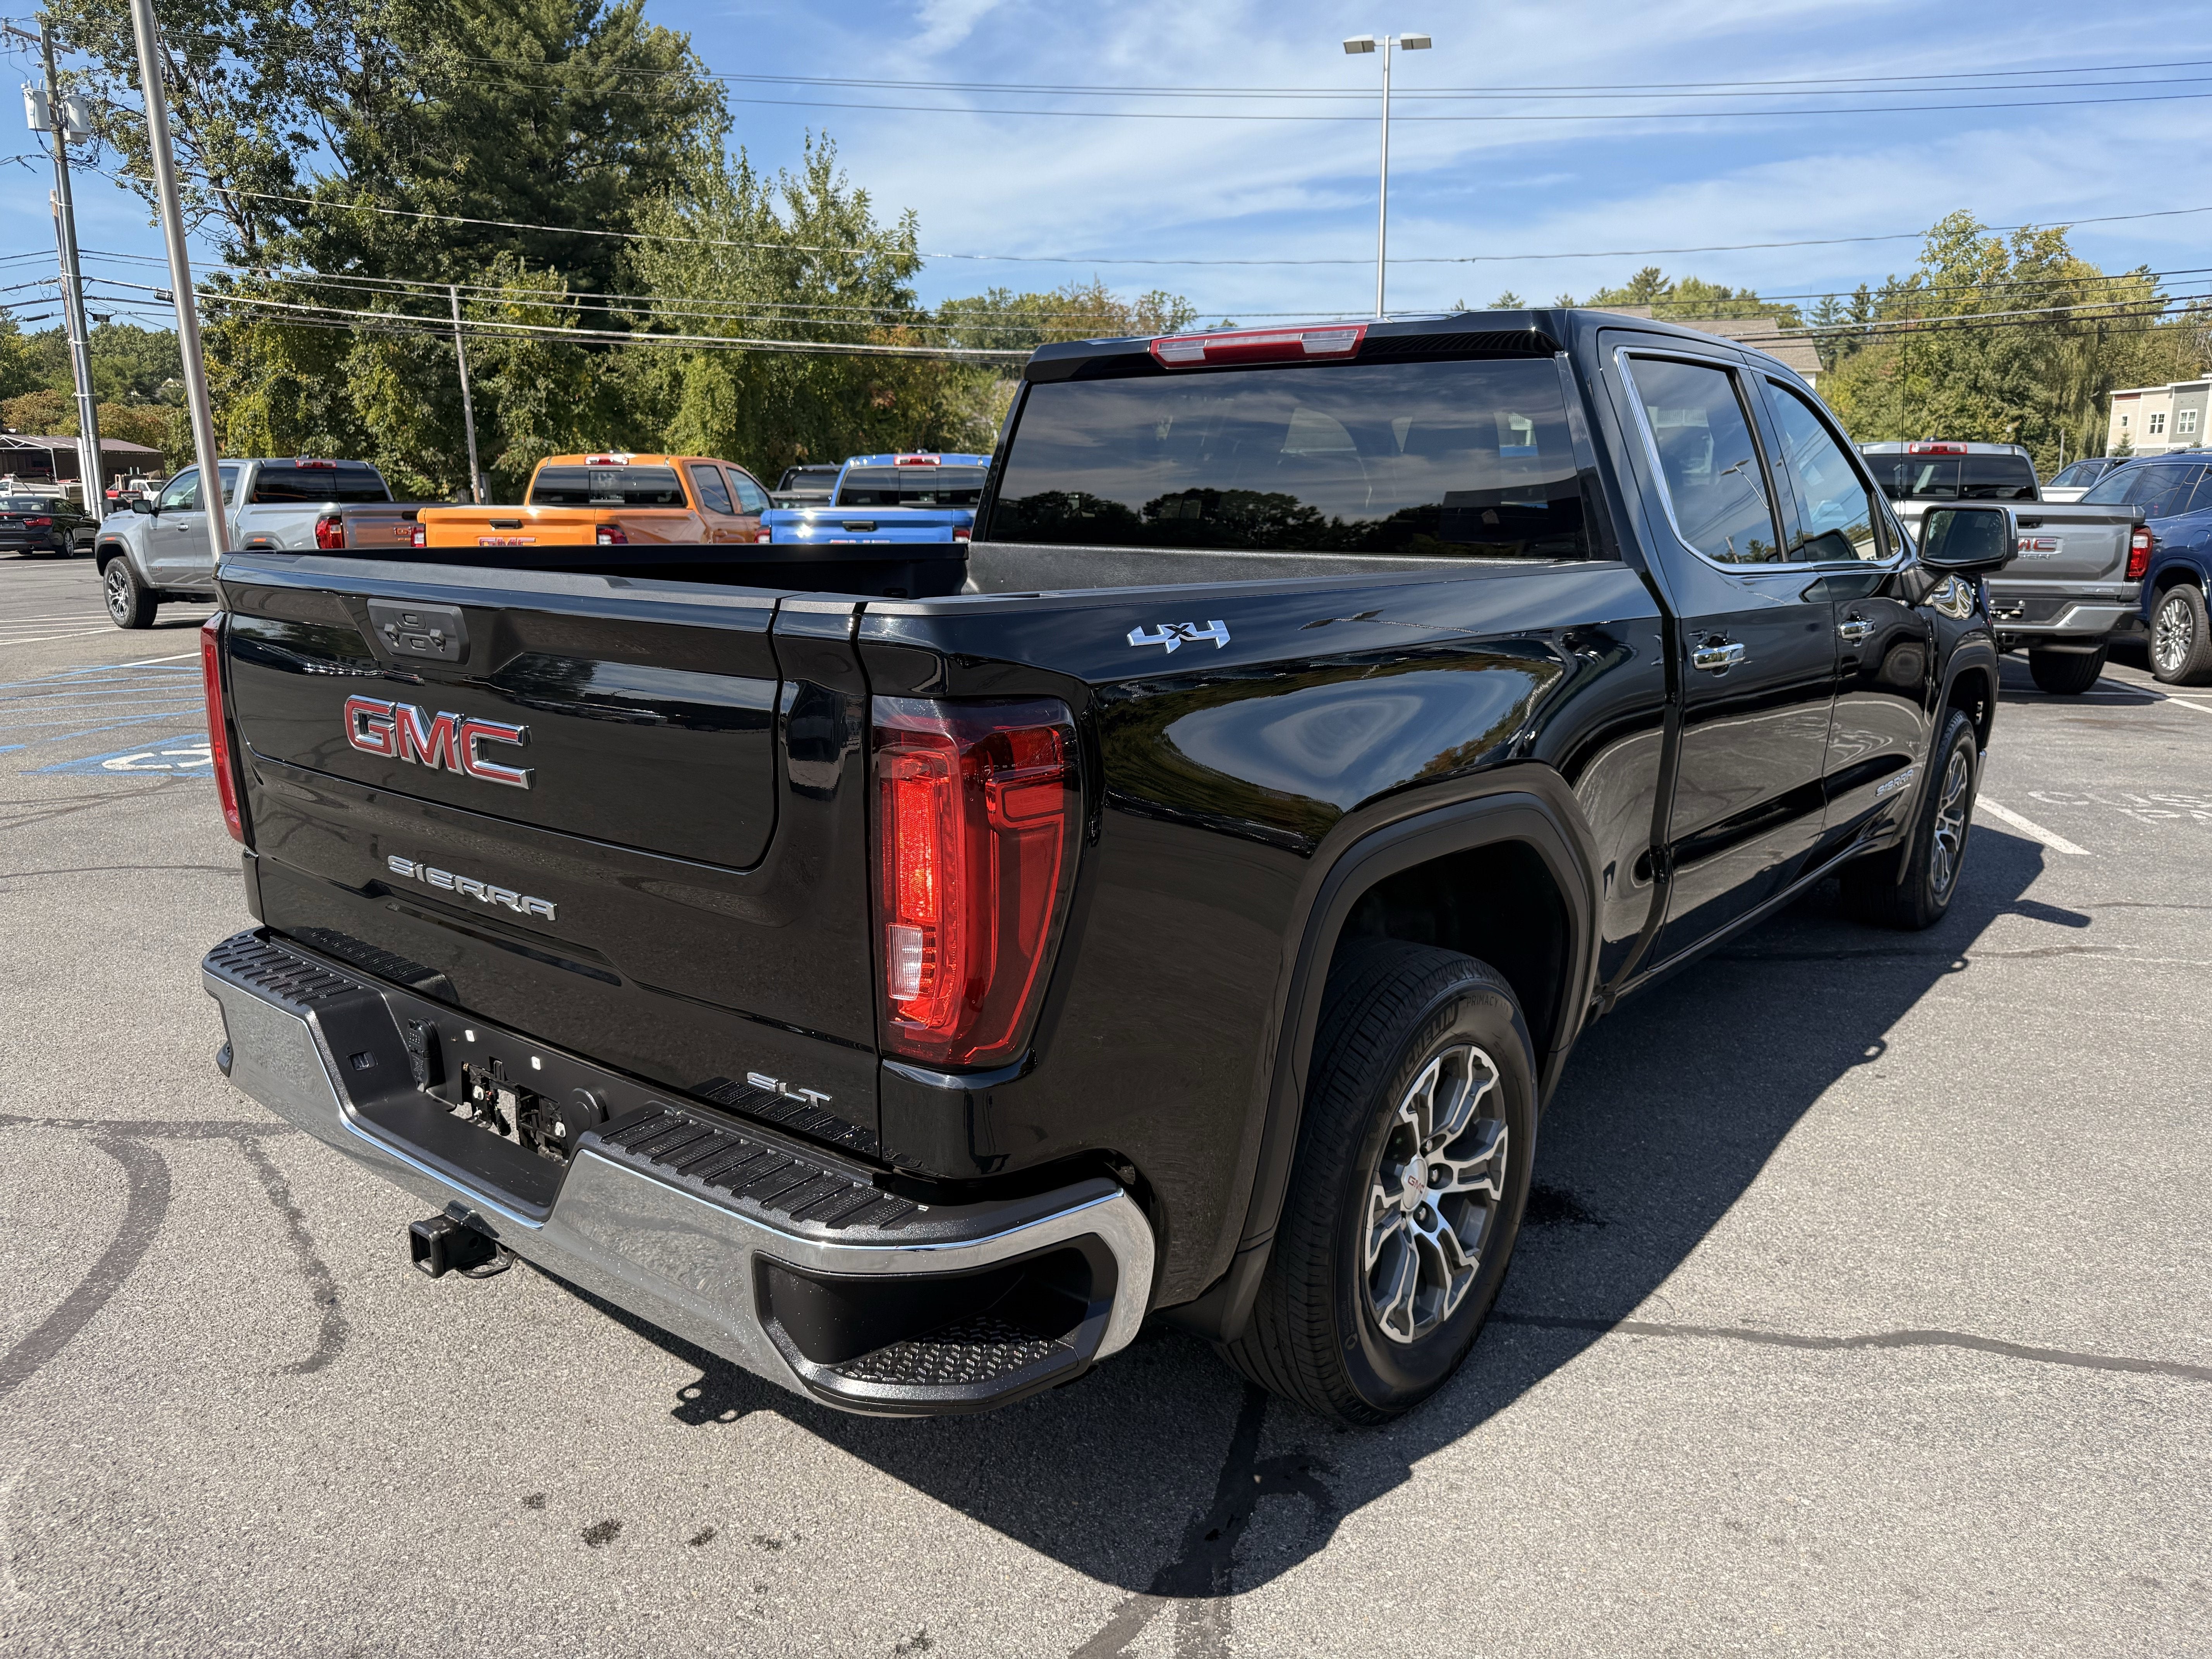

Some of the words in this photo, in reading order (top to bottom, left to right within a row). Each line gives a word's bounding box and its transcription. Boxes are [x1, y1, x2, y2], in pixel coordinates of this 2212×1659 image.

[344, 694, 536, 790] GMC
[388, 855, 558, 921] SIERRA
[1387, 1003, 1456, 1108] MICHELIN
[1466, 994, 1499, 1007] PRIMACY
[747, 1071, 832, 1107] SLT
[1408, 1175, 1425, 1194] GMC
